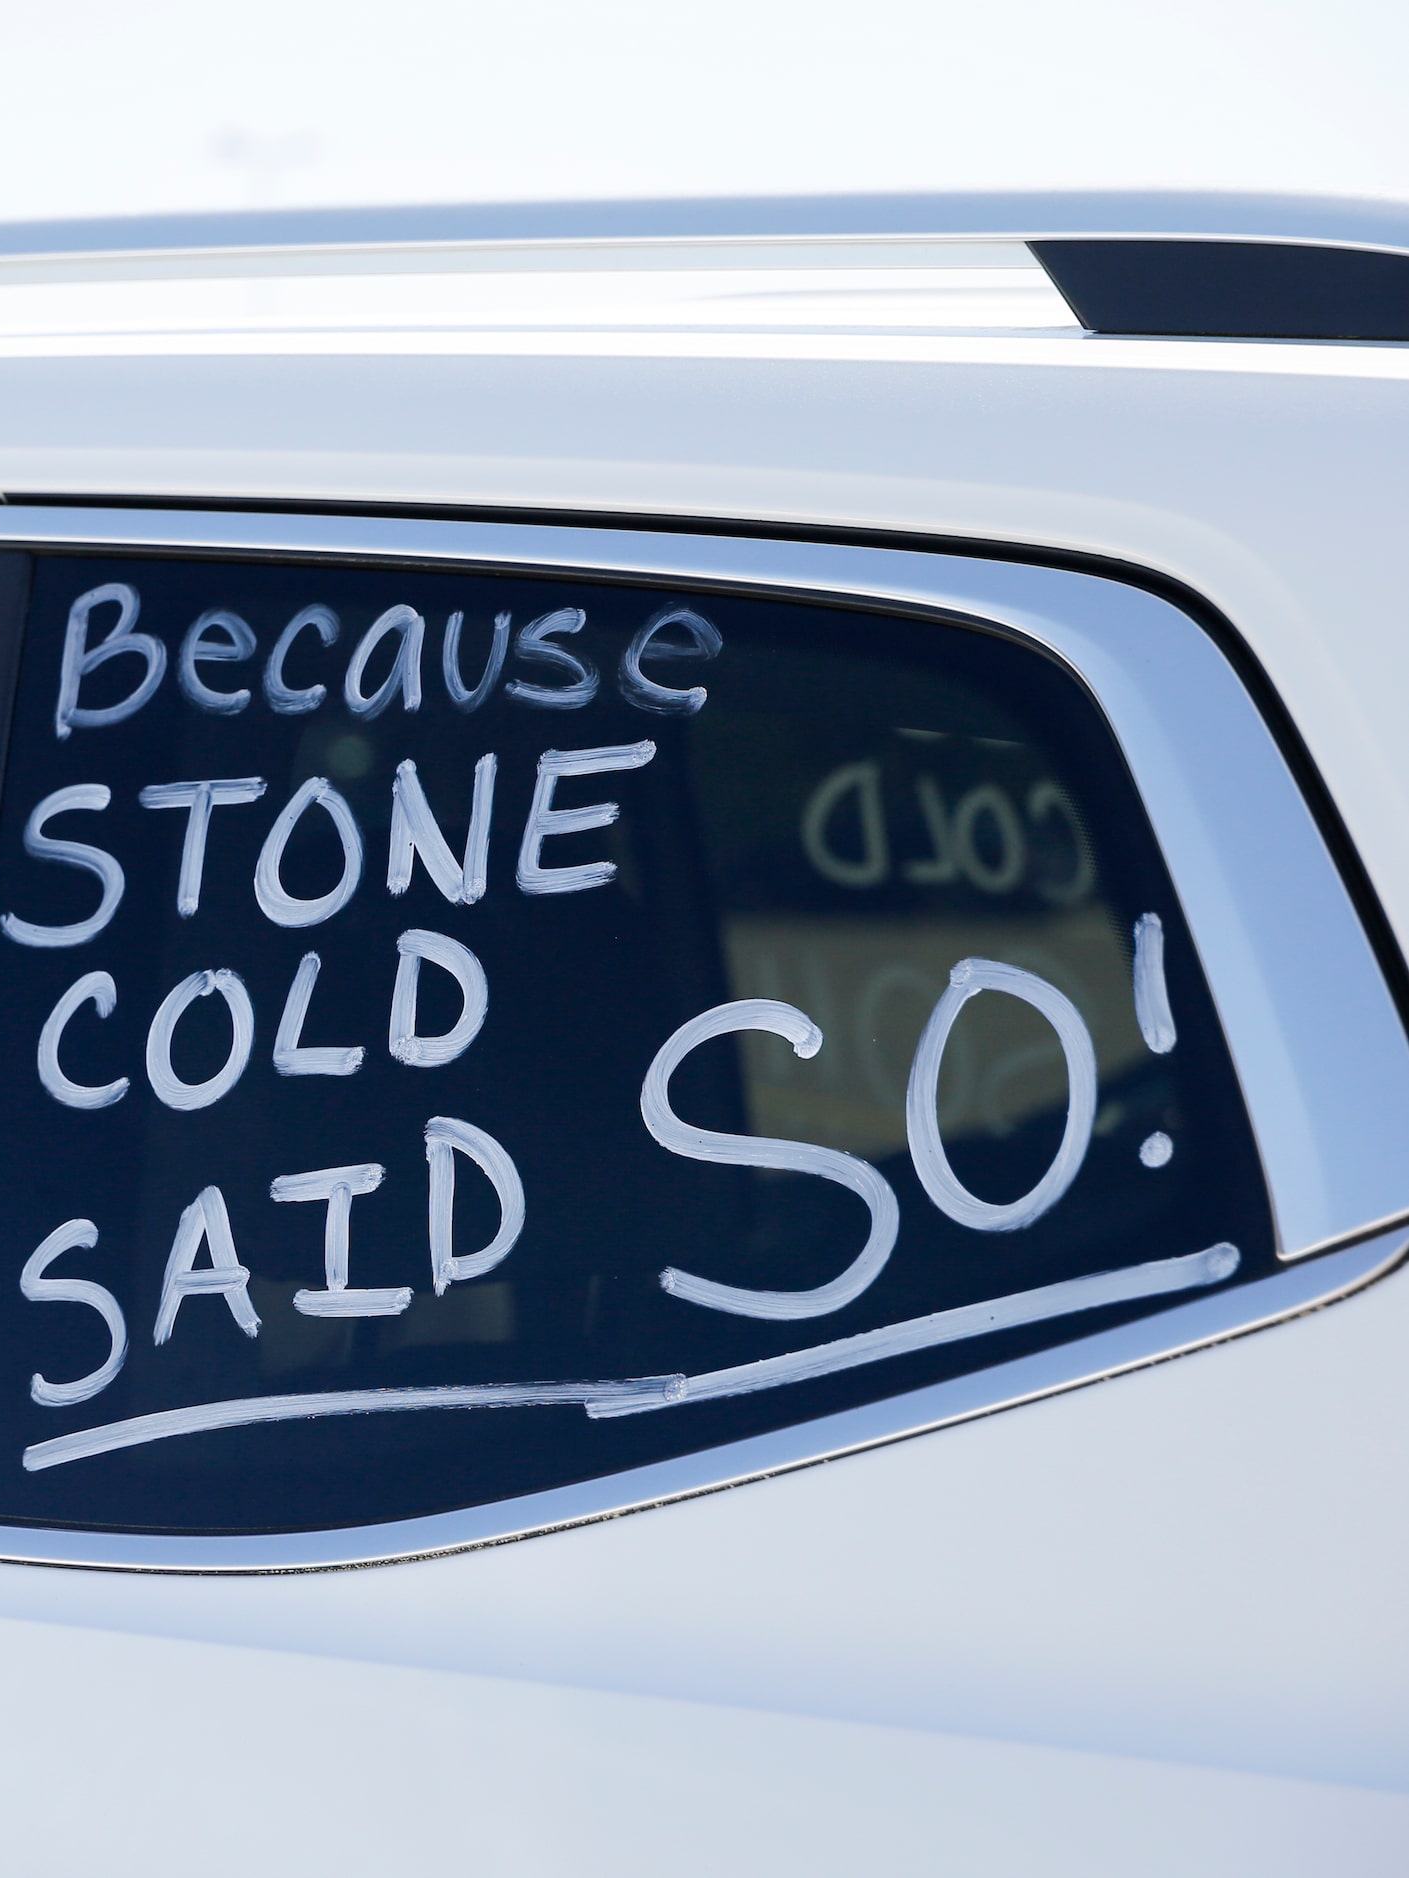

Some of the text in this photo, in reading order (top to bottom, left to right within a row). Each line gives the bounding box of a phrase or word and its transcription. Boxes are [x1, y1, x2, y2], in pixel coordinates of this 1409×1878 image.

[55, 582, 724, 740] Because
[0, 739, 658, 948] STONE
[36, 928, 489, 1111] COLD
[19, 911, 1177, 1407] SAID SO!
